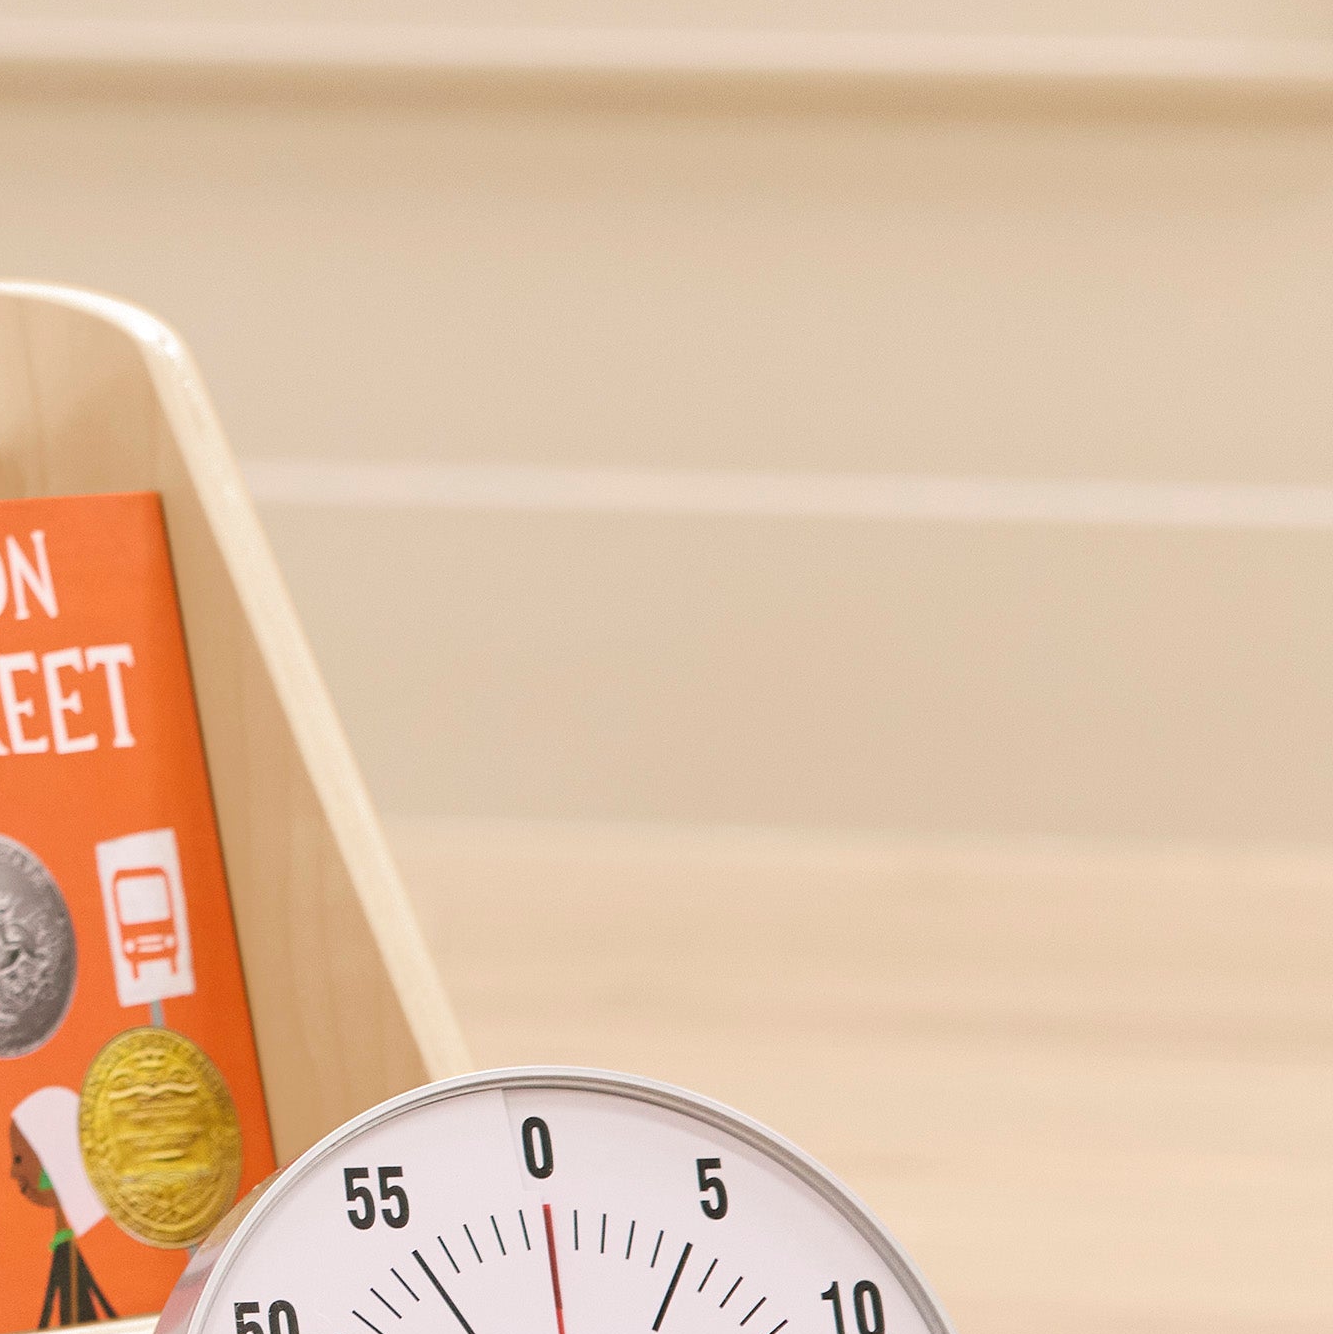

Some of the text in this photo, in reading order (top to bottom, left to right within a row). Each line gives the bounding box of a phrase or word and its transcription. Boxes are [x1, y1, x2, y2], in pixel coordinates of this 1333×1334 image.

[521, 1116, 554, 1180] 0
[343, 1166, 410, 1231] 55
[695, 1157, 729, 1221] 5
